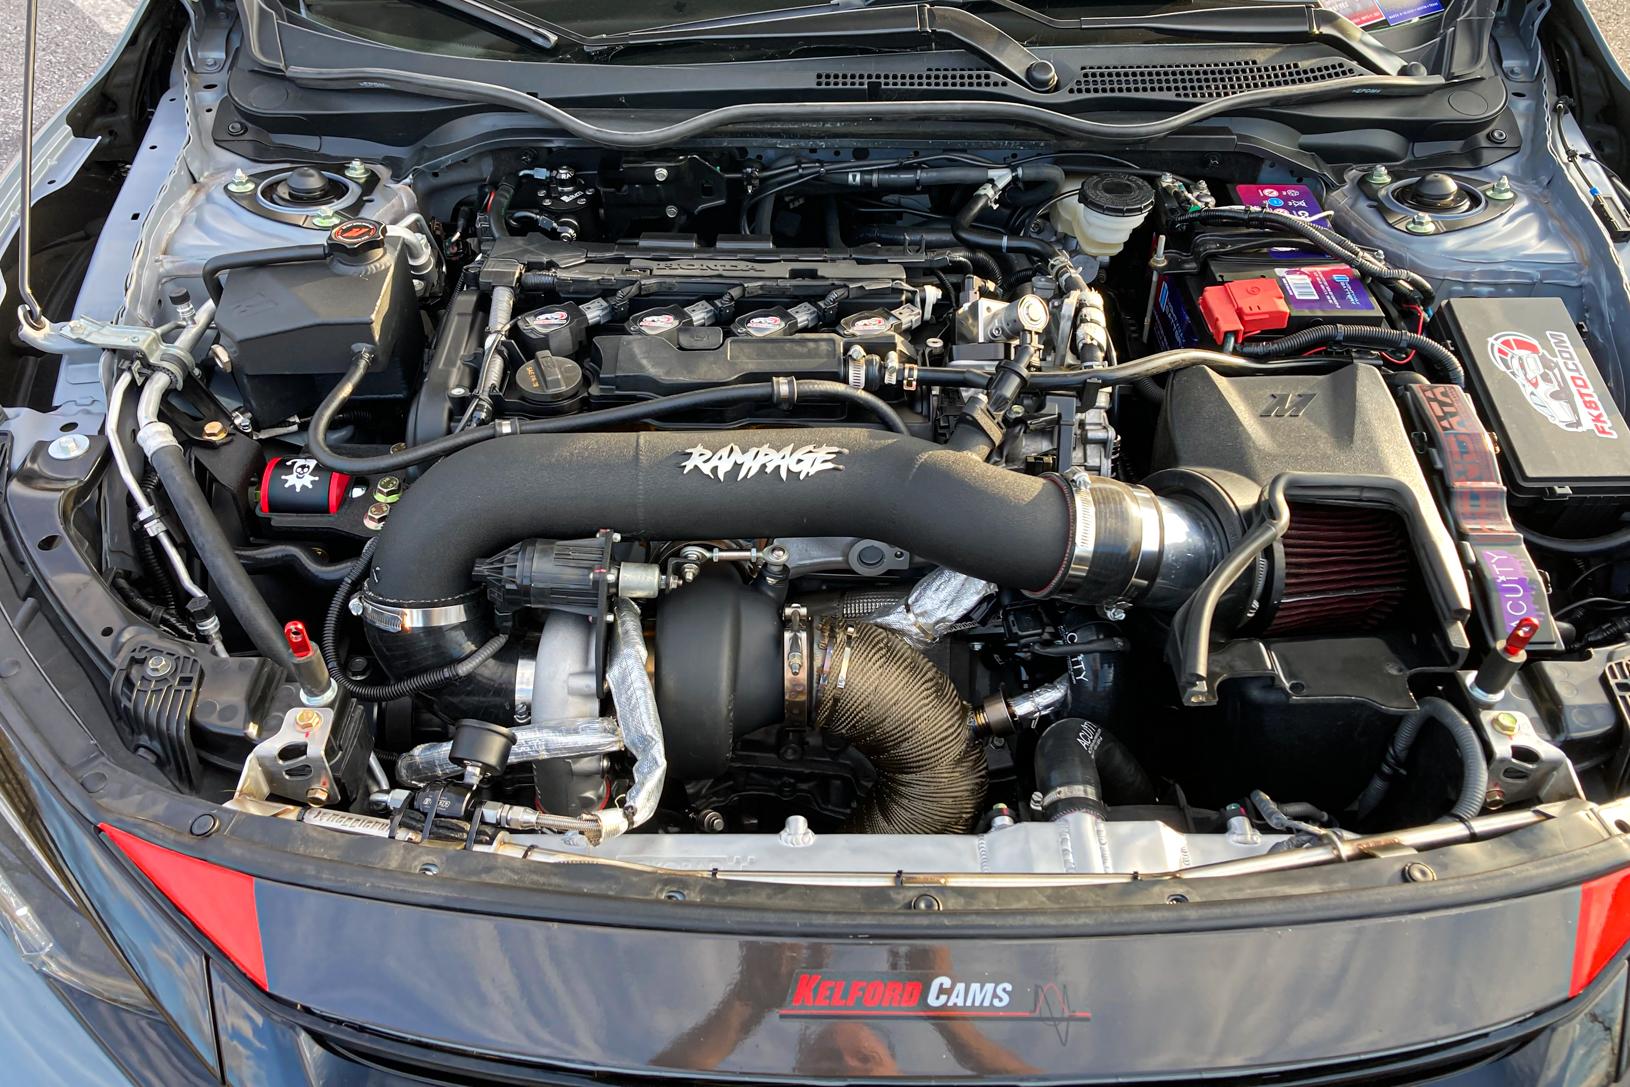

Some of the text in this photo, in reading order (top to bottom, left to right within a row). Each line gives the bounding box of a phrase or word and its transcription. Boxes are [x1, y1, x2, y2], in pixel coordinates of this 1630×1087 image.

[681, 442, 850, 483] RAMPAGE
[791, 974, 1013, 1008] KELFORD CAMS
